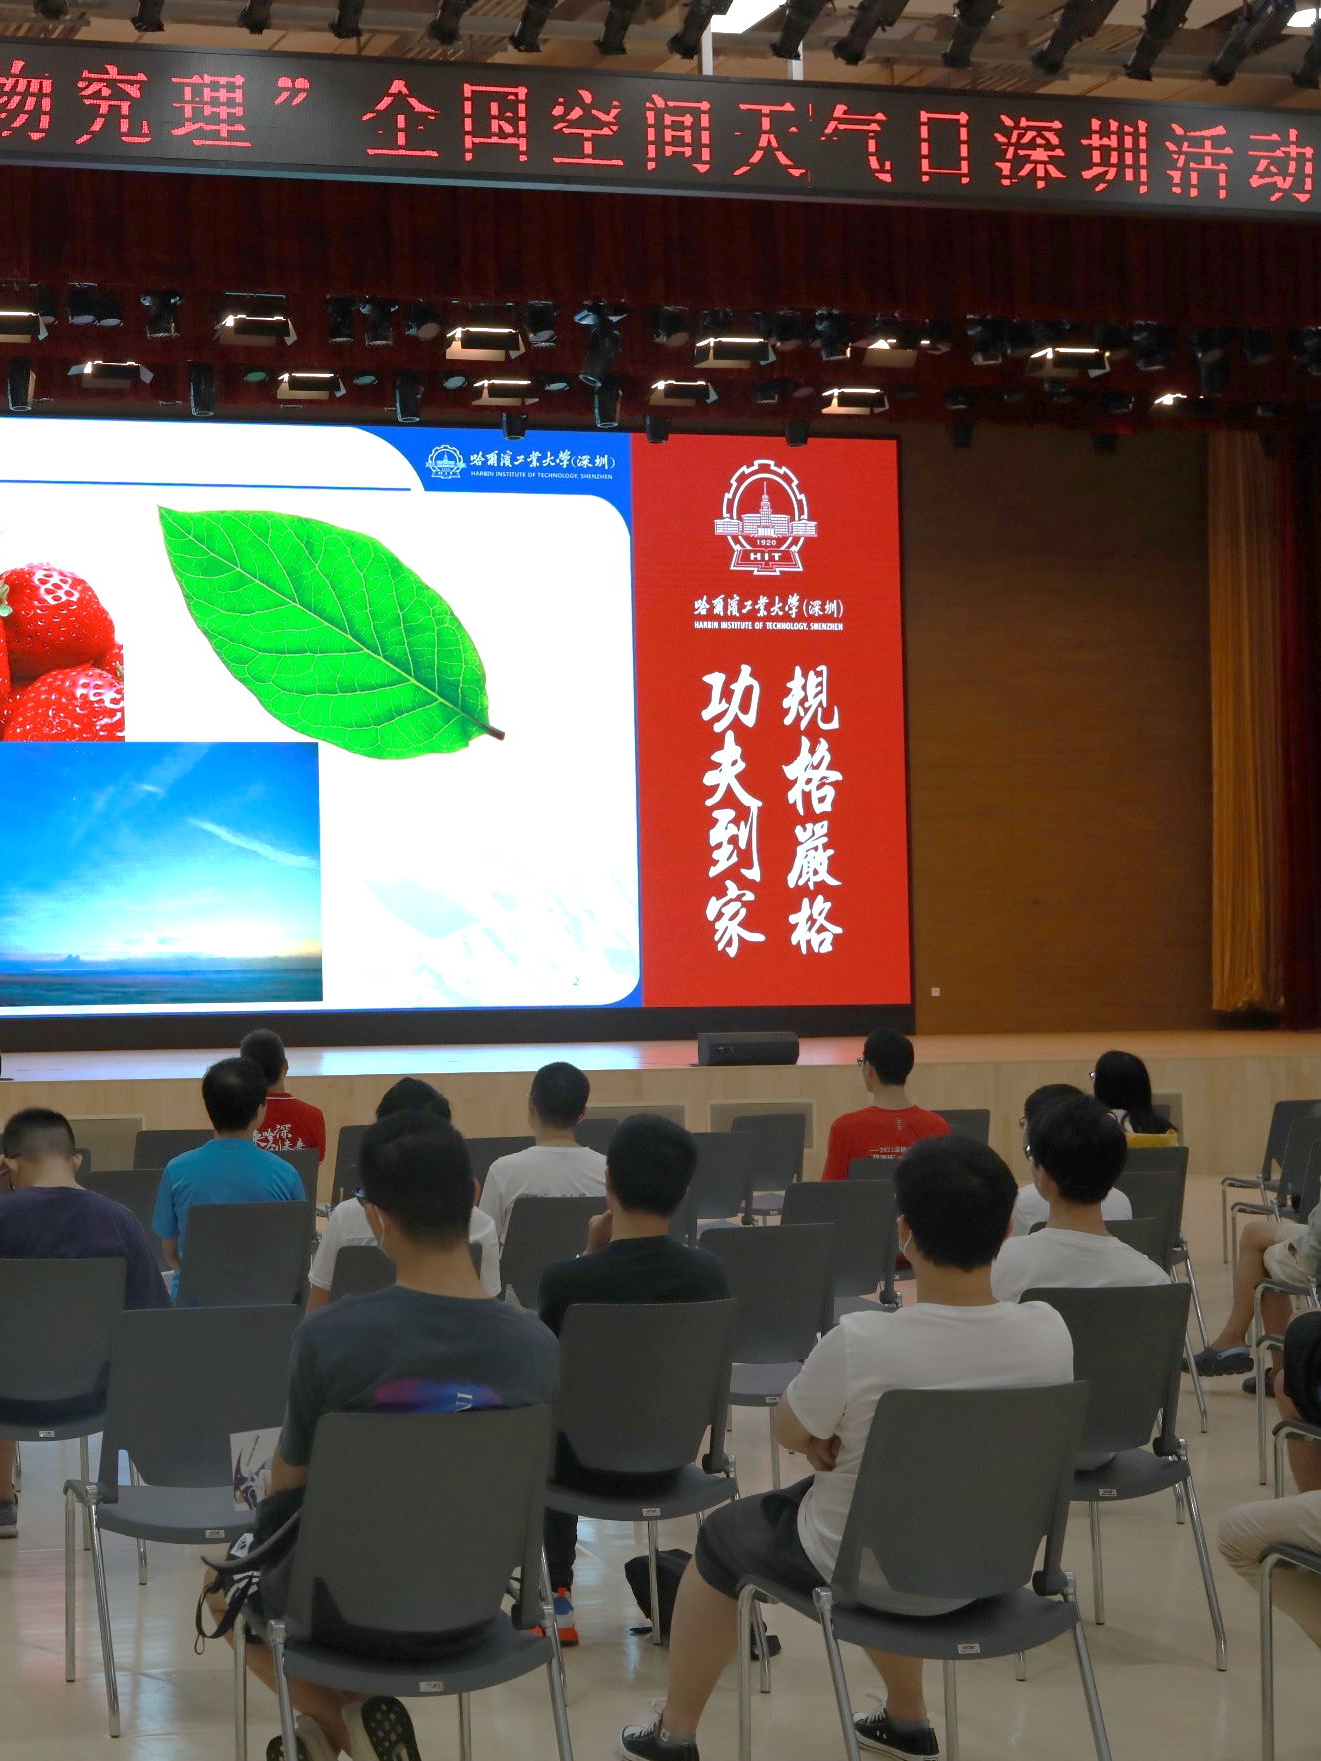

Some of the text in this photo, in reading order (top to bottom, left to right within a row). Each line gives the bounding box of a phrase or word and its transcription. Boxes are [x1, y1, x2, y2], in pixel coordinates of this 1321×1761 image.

[756, 539, 777, 547] 1920
[749, 552, 783, 562] HIT
[694, 620, 719, 629] HARBIN
[720, 621, 753, 630] INSTITUTE
[754, 621, 764, 630] OF
[809, 622, 844, 631] SHENZHEN
[700, 663, 766, 958] 功夫到家
